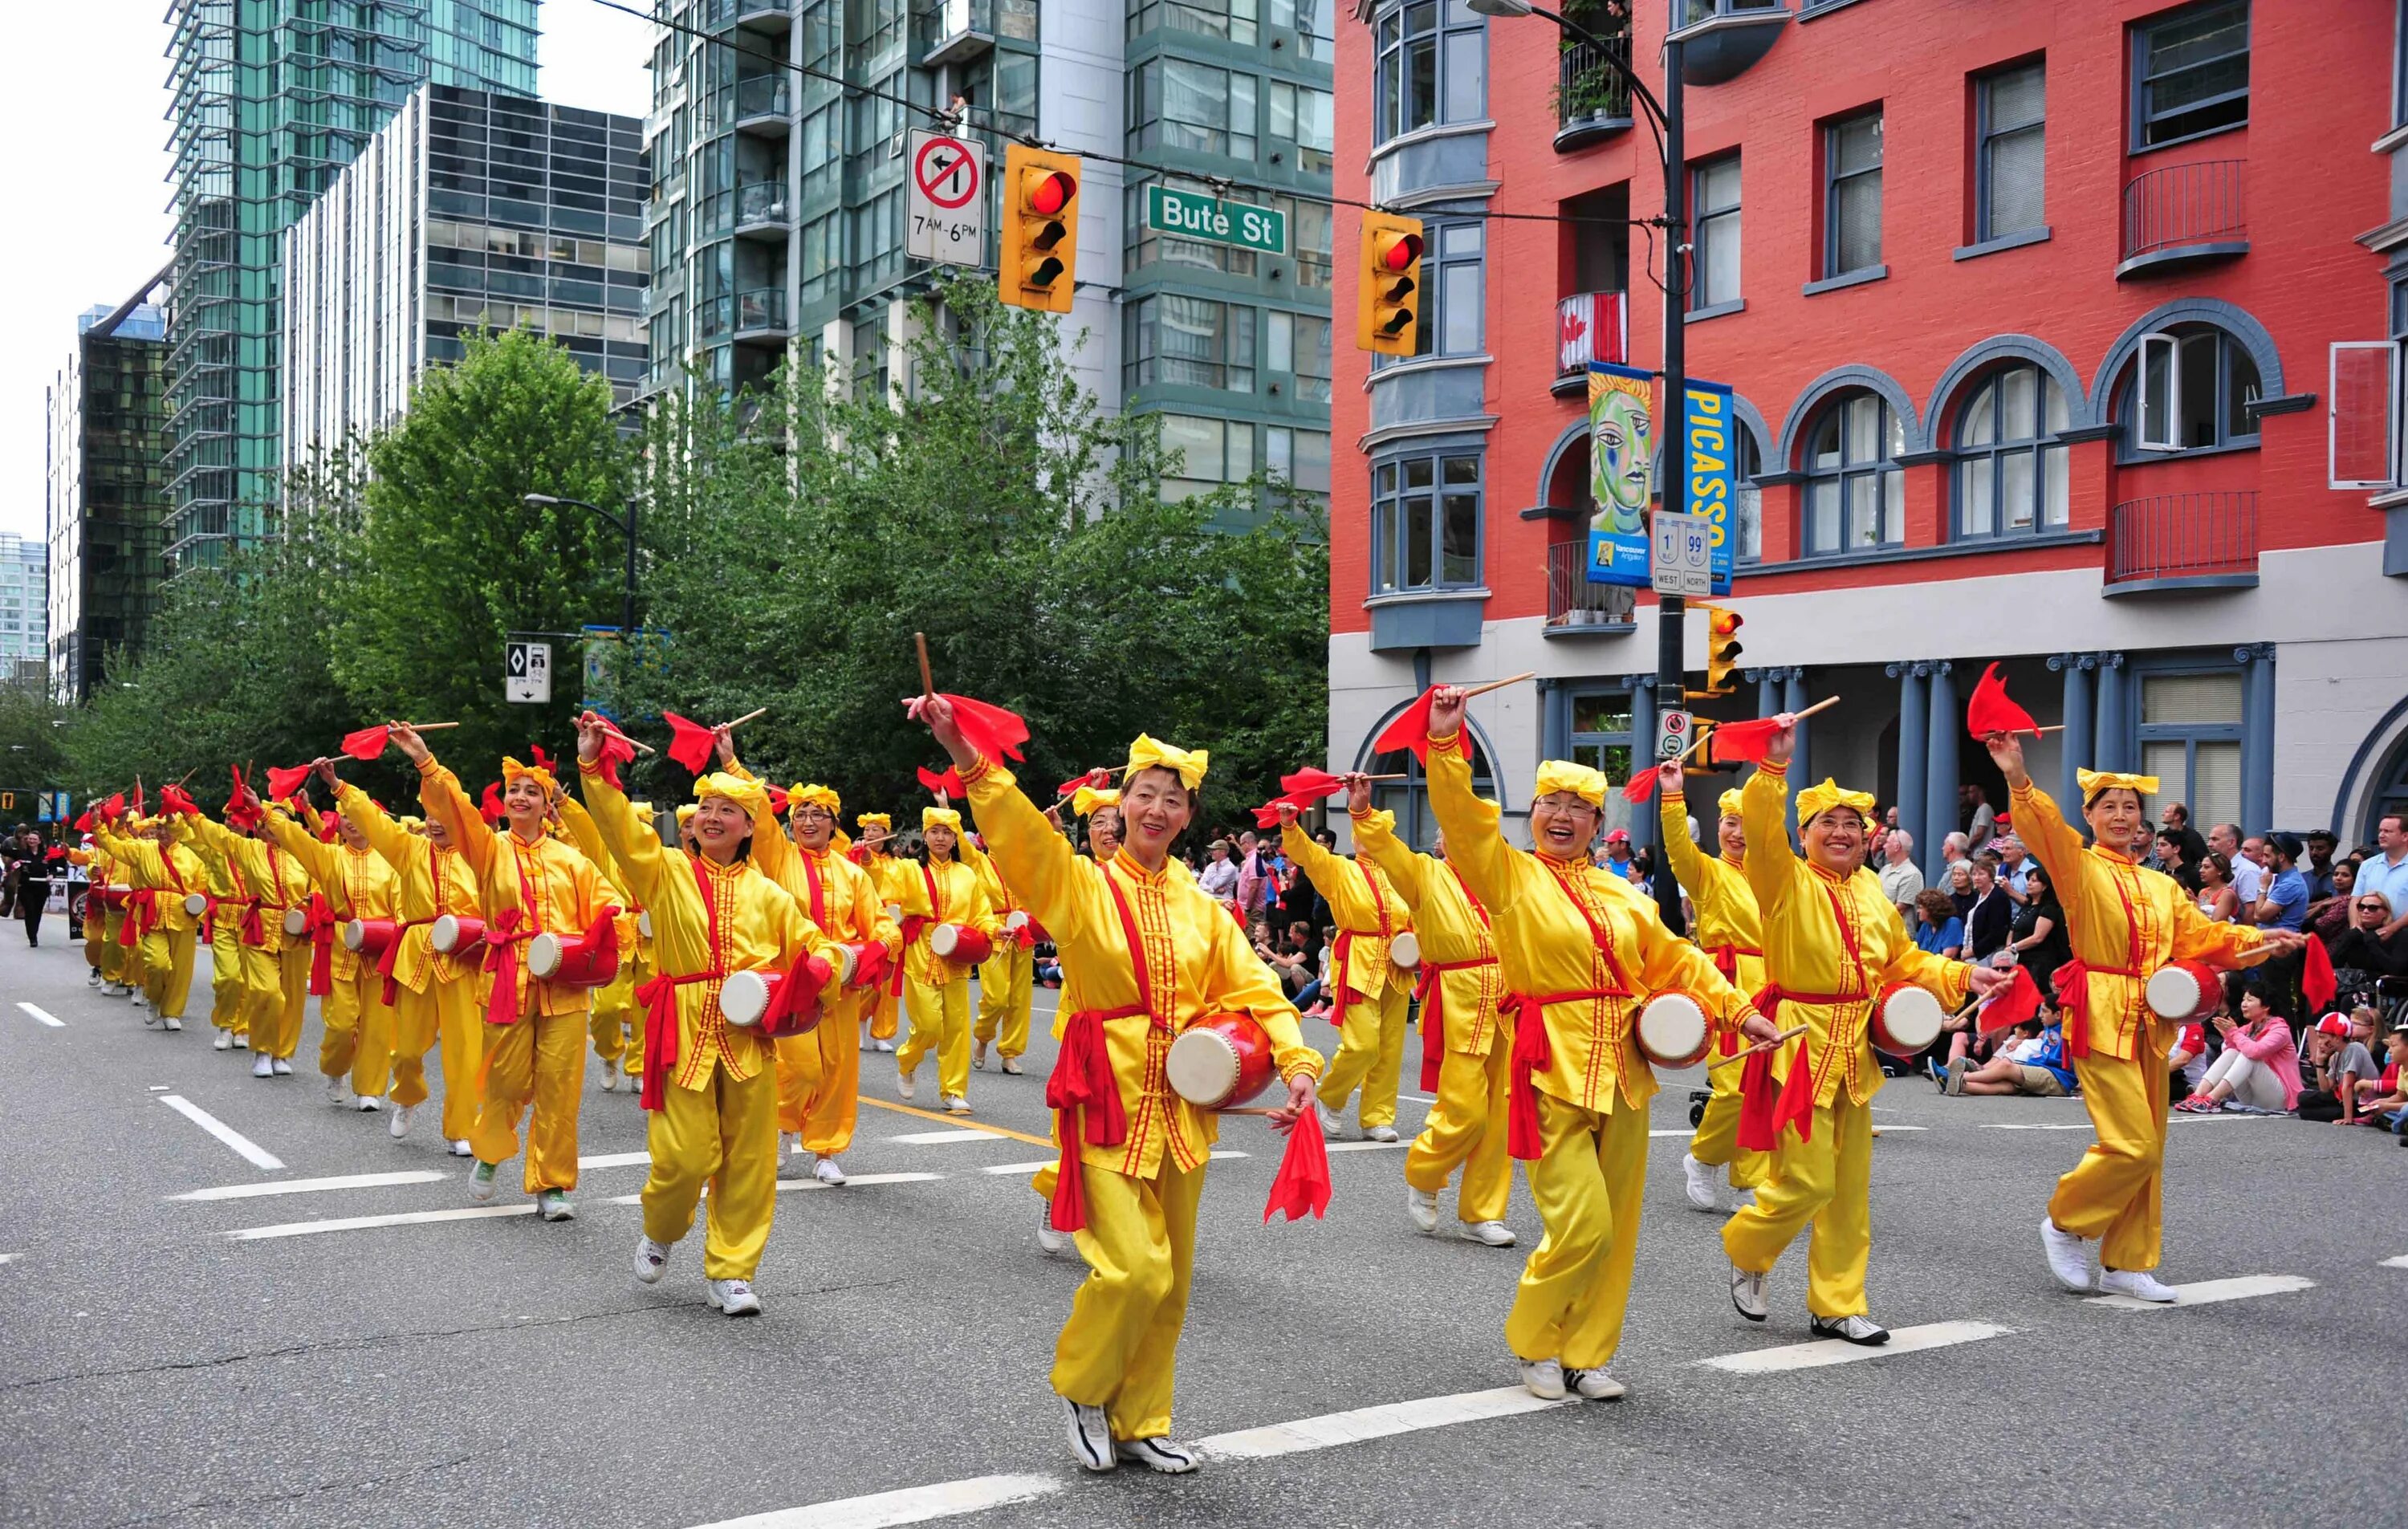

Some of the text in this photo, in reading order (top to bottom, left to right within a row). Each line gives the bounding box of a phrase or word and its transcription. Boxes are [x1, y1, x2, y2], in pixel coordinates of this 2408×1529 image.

[1163, 197, 1273, 245] Bute St
[1615, 543, 1647, 555] Vancouver
[1688, 535, 1702, 552] 99
[1658, 574, 1678, 585] WEST
[1686, 577, 1706, 587] NORTH
